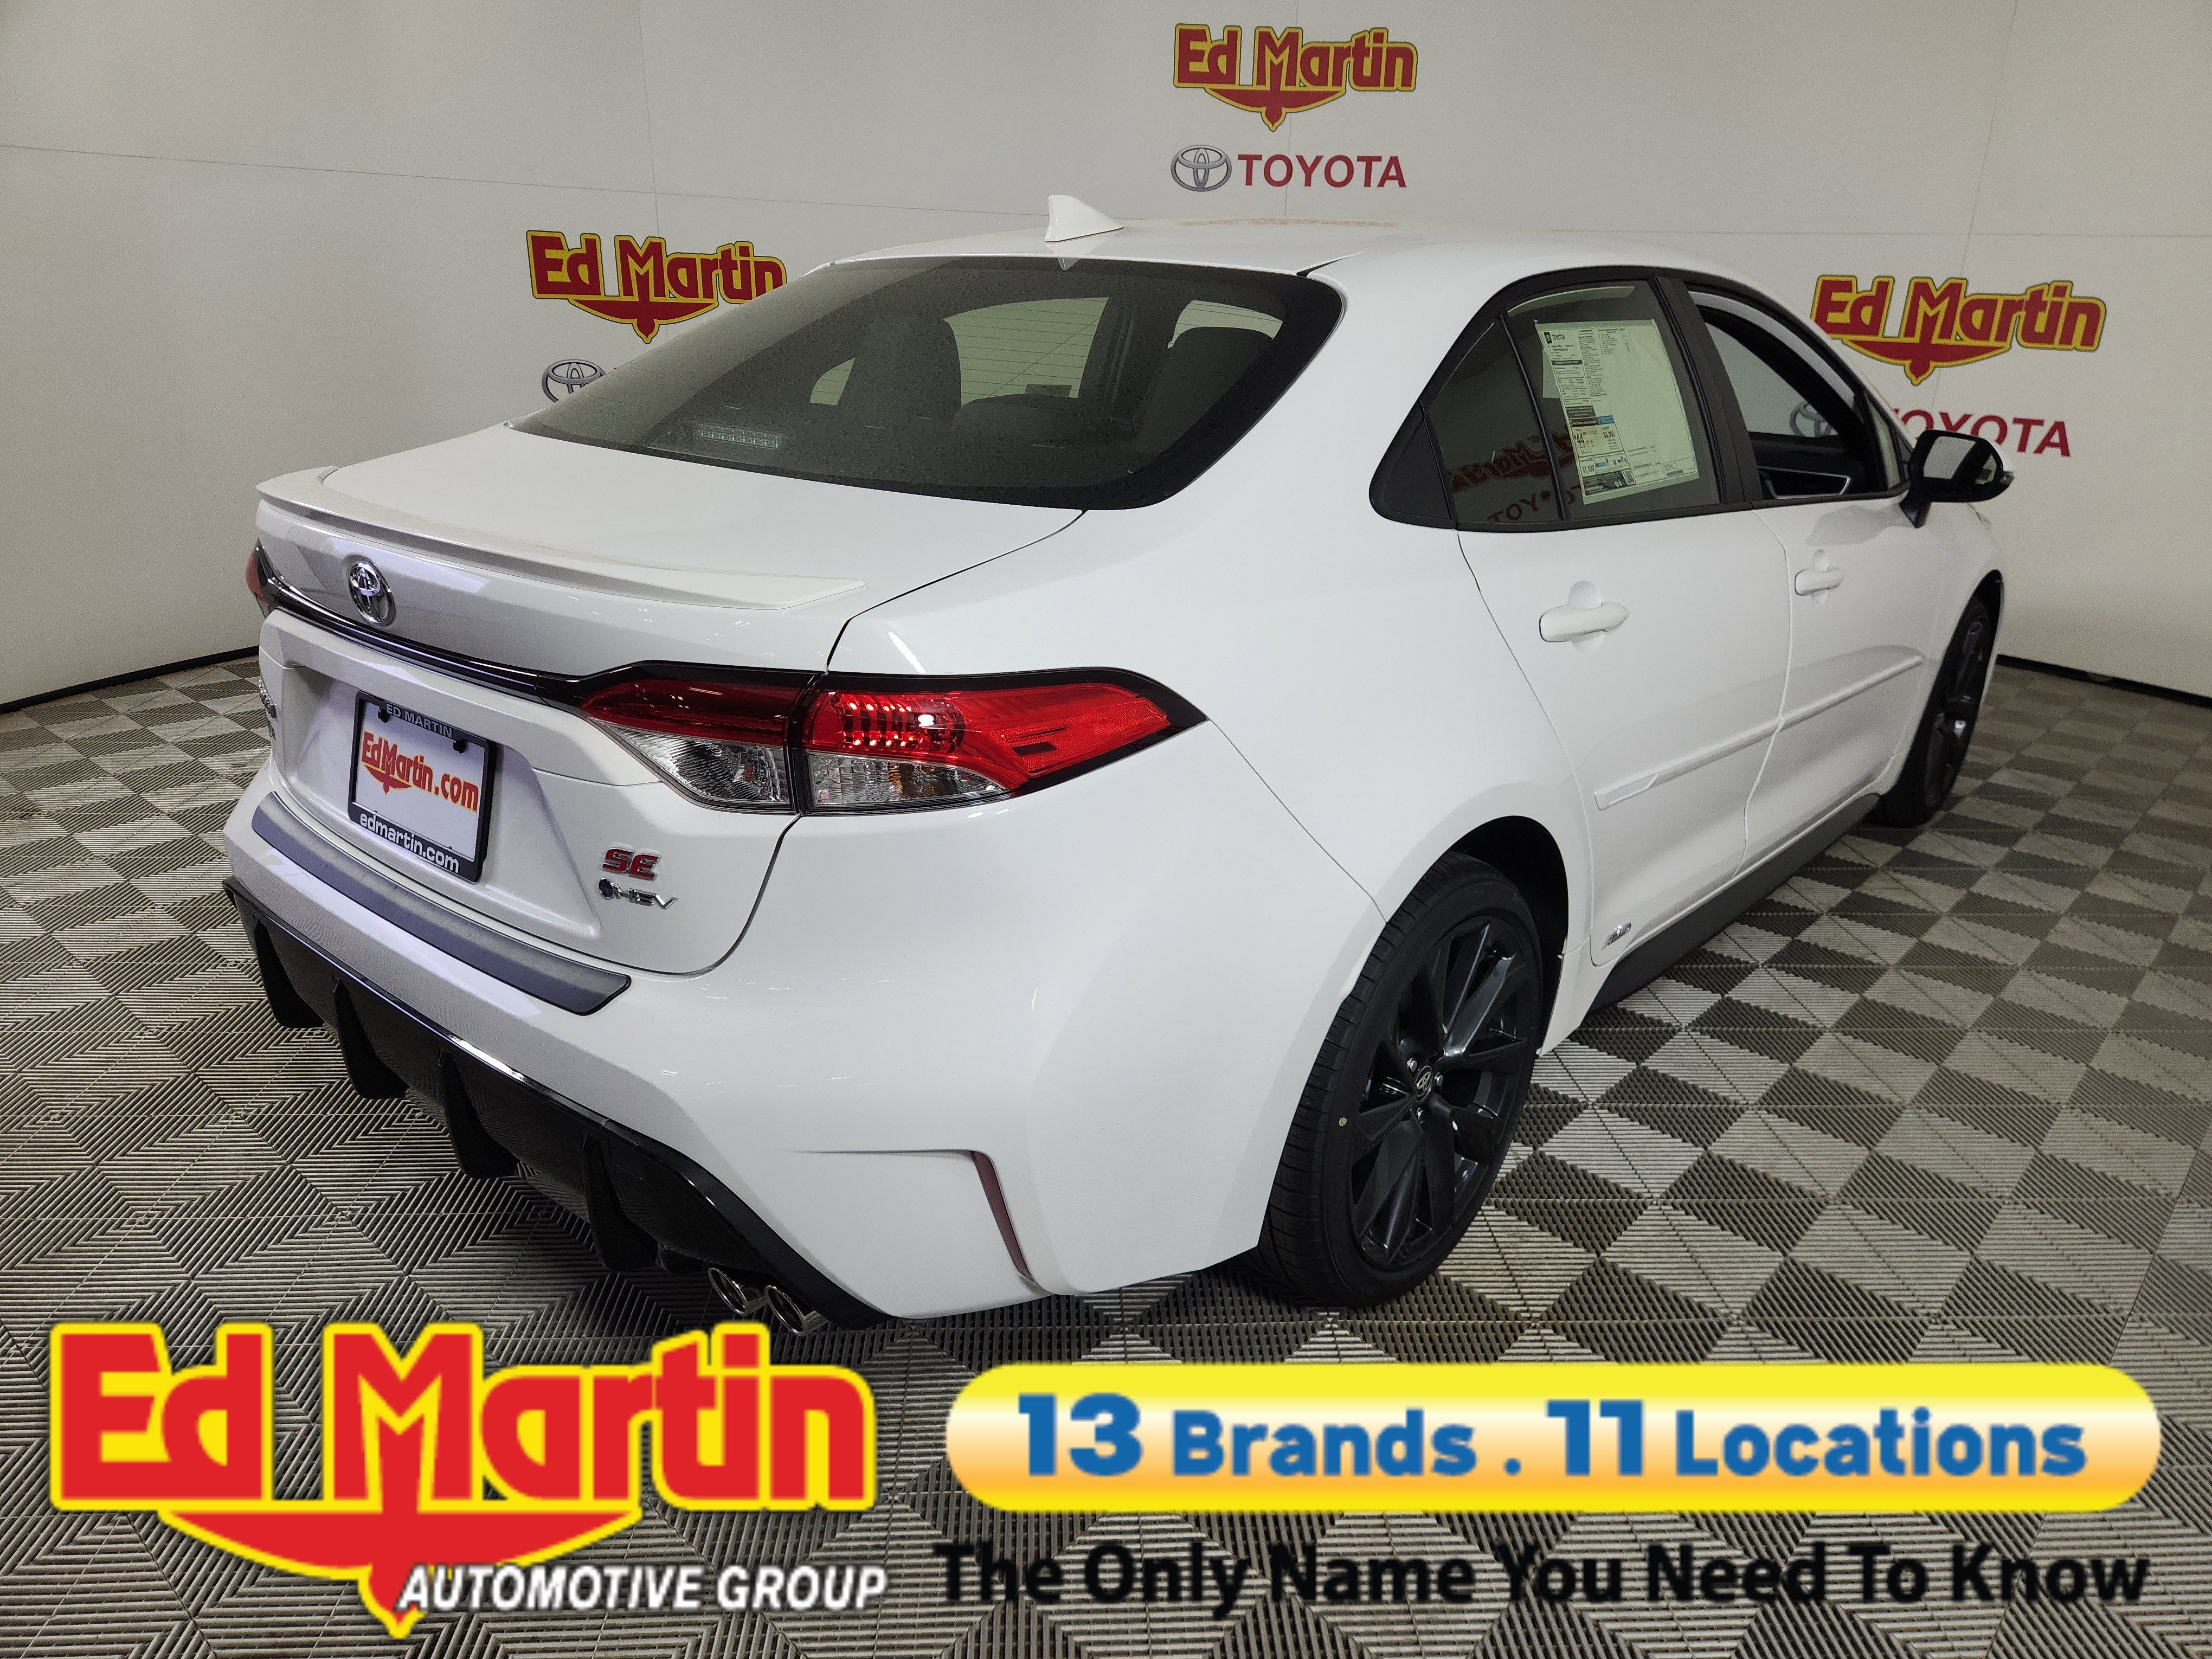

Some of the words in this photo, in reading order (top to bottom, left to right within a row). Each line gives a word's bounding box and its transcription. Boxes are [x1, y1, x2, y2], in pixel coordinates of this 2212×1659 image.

[1176, 25, 1239, 86] Ed
[1255, 29, 1416, 88] Martin
[1238, 154, 1406, 188] TOYOTA
[529, 233, 600, 297] Ed
[616, 237, 785, 301] Martin
[1813, 277, 1892, 337] Ed
[1900, 278, 2104, 349] Martin
[1894, 409, 2071, 457] OYOTA
[387, 704, 401, 717] ED
[404, 710, 453, 738] MARTIN
[360, 813, 459, 873] edmartin.com
[602, 847, 662, 881] SE
